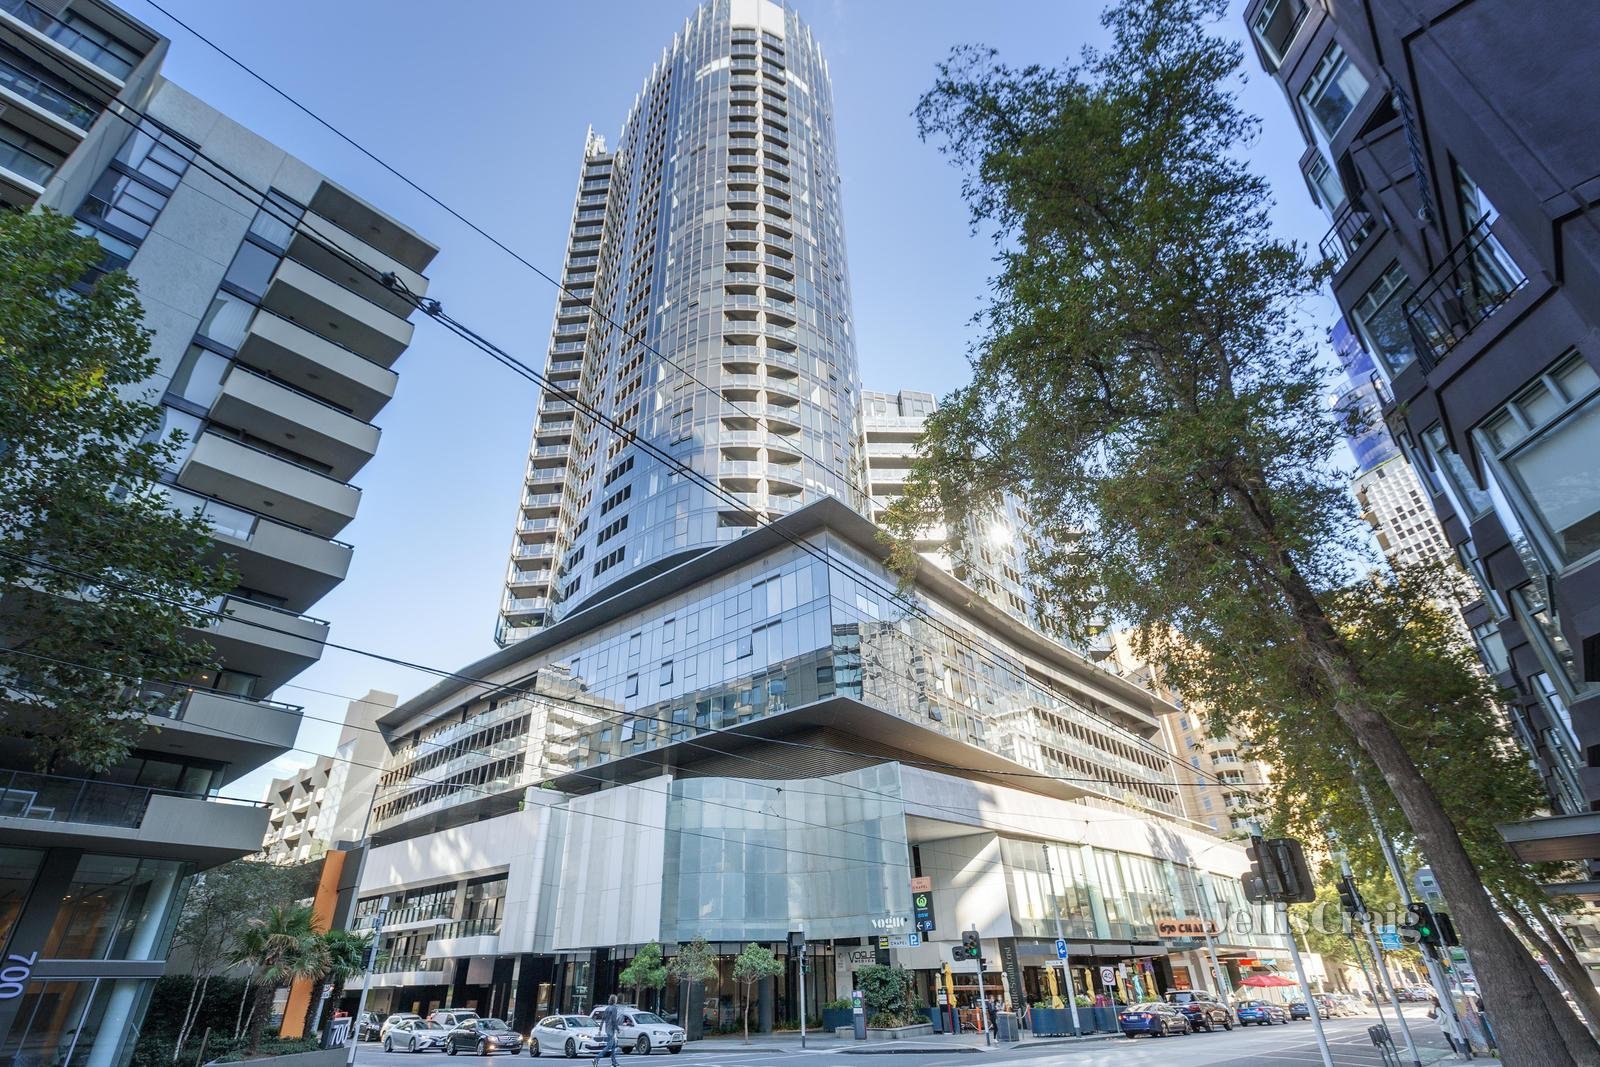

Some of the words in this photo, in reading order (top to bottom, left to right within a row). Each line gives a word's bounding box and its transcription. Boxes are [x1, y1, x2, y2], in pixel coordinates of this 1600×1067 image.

[0, 951, 38, 999] 700
[1104, 972, 1112, 980] 40
[331, 1023, 348, 1046] 700
